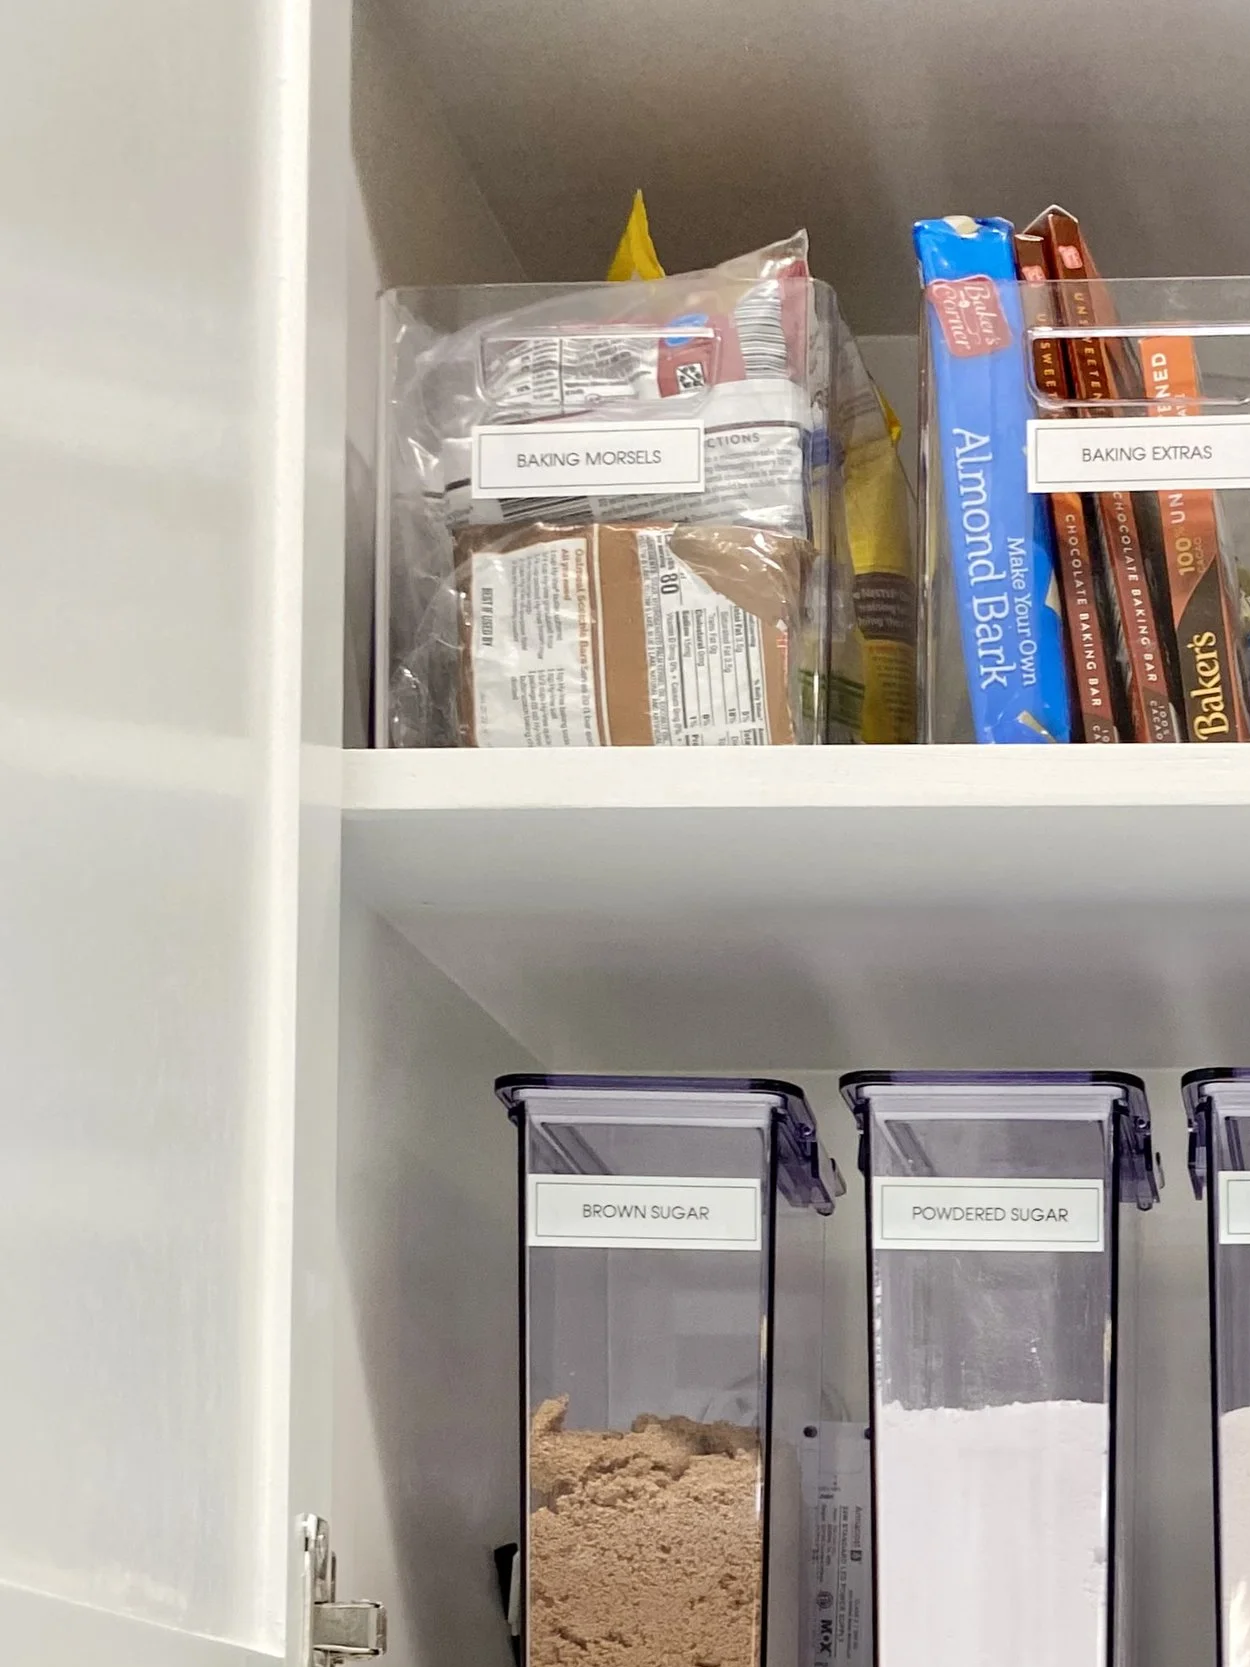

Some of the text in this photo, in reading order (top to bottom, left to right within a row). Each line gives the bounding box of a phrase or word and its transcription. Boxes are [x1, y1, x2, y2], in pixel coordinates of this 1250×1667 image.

[932, 284, 971, 350] Corner
[964, 284, 1001, 345] Baker's
[516, 450, 662, 468] BAKING MORSELS
[1082, 446, 1212, 462] BAKING EXTRAS
[953, 428, 1016, 690] Almond Bark
[481, 588, 494, 605] BEST
[660, 573, 680, 595] 80
[482, 615, 493, 636] USED
[1007, 536, 1038, 686] Make Your Own
[1065, 514, 1102, 706] CHOCOLATE BAKING BAR
[481, 636, 494, 647] BY
[1131, 589, 1151, 645] BAKING
[1143, 653, 1158, 682] BAR
[1187, 632, 1230, 740] Baker's
[1150, 700, 1163, 740] CACAO
[582, 1204, 710, 1220] BROWN SUGAR
[912, 1206, 1069, 1222] POWDERED SUGAR
